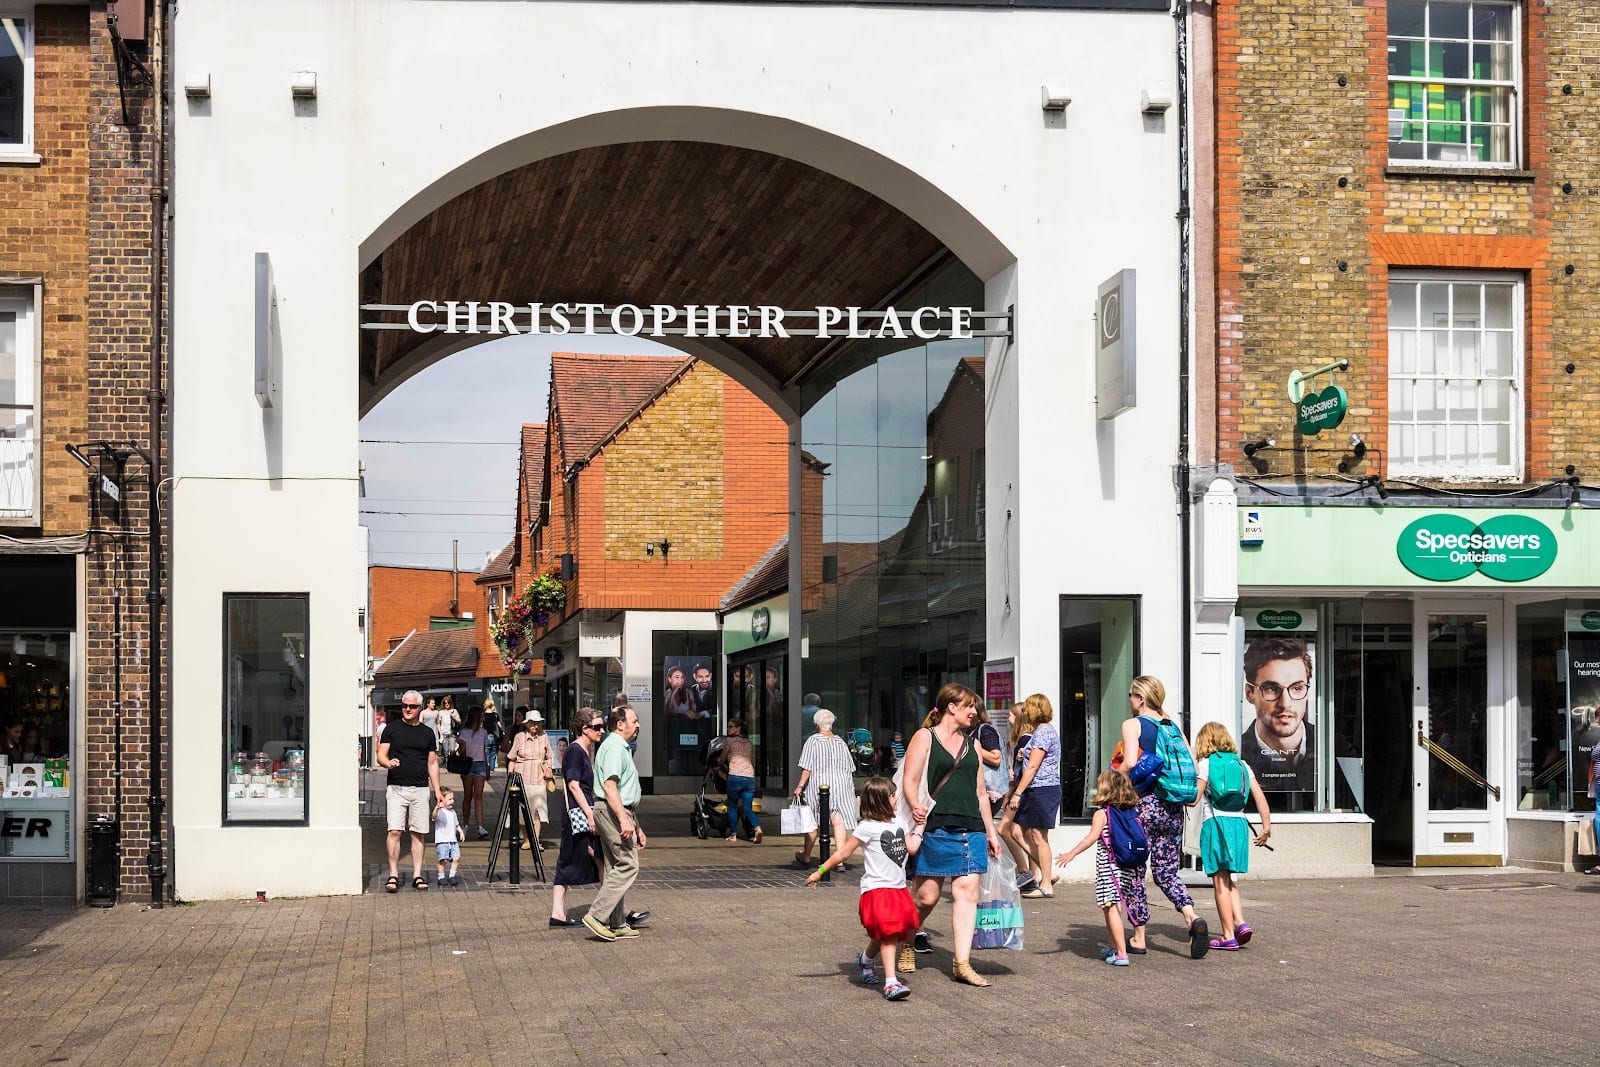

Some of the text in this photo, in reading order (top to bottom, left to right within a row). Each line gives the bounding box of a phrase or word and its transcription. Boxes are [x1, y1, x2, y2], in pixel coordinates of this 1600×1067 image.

[407, 300, 973, 339] CHRISTOPHER PLACE
[1301, 397, 1338, 419] Specsavers
[1415, 528, 1541, 553] Specsavers
[1449, 551, 1507, 565] Opticians
[1261, 614, 1298, 622] Specsavers
[1573, 661, 1586, 669] Our
[490, 682, 518, 693] KUONI
